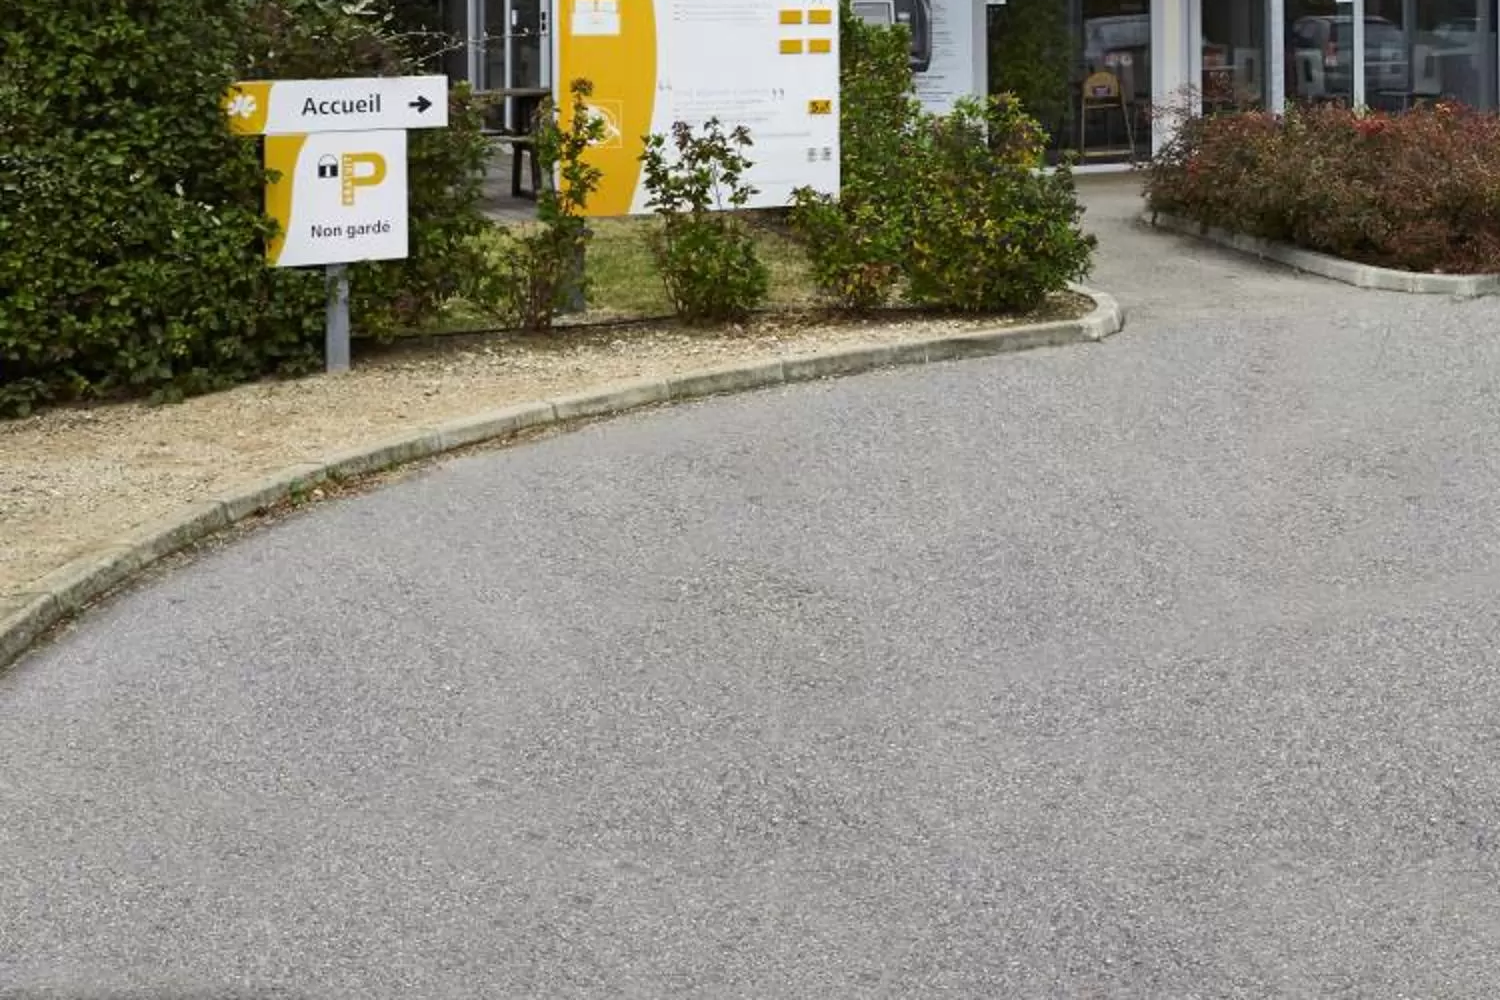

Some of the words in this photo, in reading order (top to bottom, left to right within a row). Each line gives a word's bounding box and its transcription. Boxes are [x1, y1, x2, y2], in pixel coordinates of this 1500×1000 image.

[302, 94, 381, 116] Accueil
[342, 152, 387, 206] P
[310, 224, 342, 238] Non
[347, 219, 391, 239] gardé
